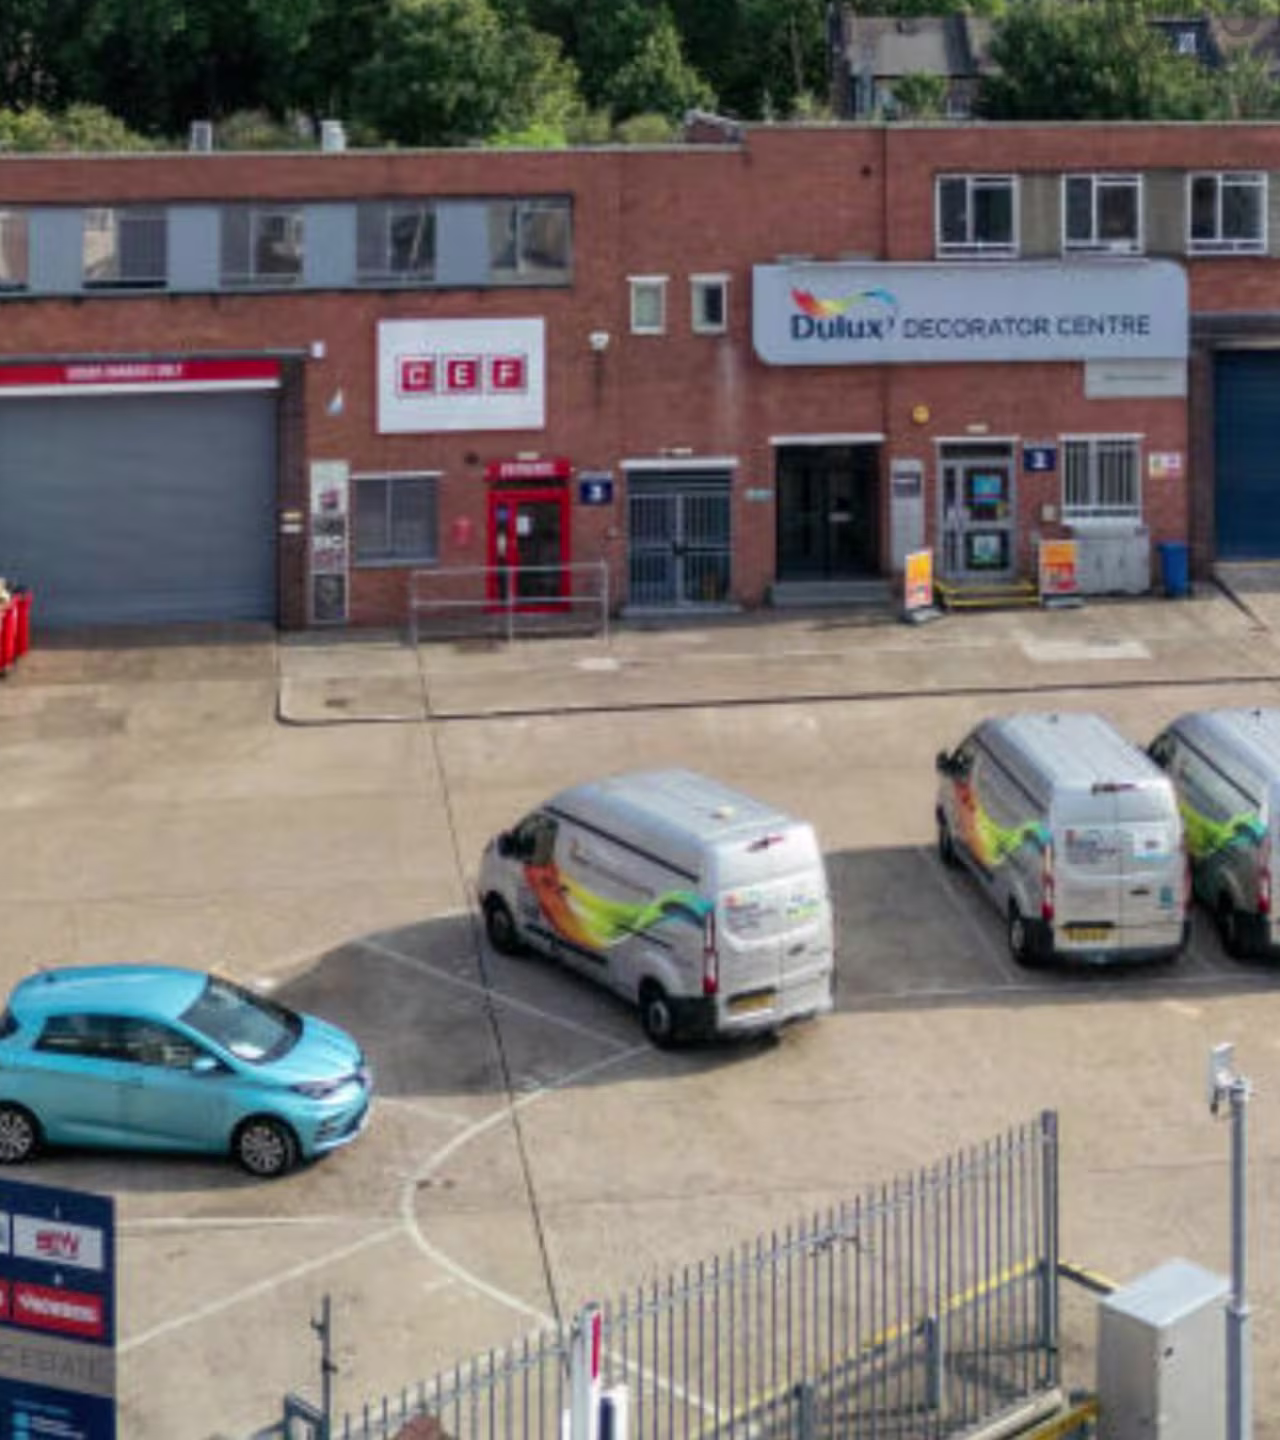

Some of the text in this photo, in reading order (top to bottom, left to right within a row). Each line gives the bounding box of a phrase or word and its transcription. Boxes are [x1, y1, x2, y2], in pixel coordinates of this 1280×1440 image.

[790, 314, 1151, 341] Dulux DECORATOR CENTRE
